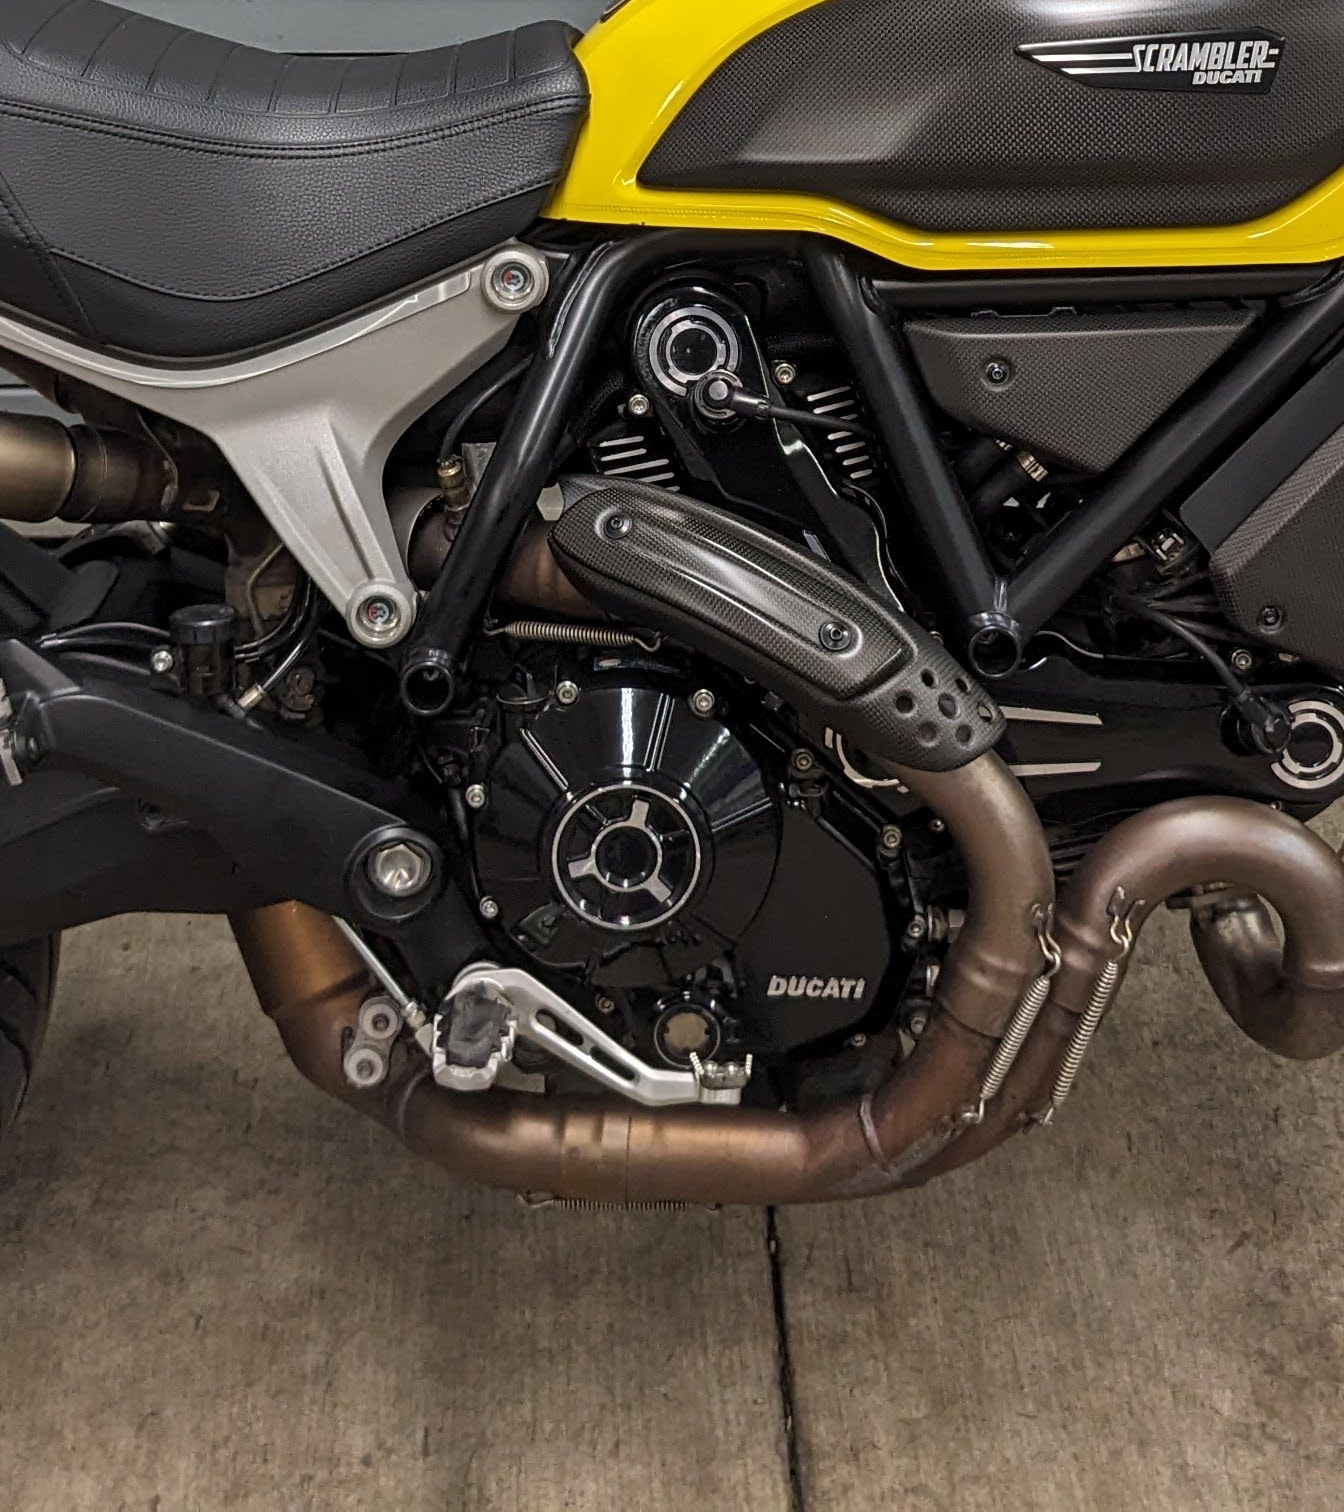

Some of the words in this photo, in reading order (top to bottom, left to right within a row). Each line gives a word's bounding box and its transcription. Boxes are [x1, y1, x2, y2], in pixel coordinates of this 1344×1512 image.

[1131, 40, 1280, 73] SCRAMBLER
[1191, 69, 1263, 85] DUCATI
[767, 975, 865, 999] DUCATI
